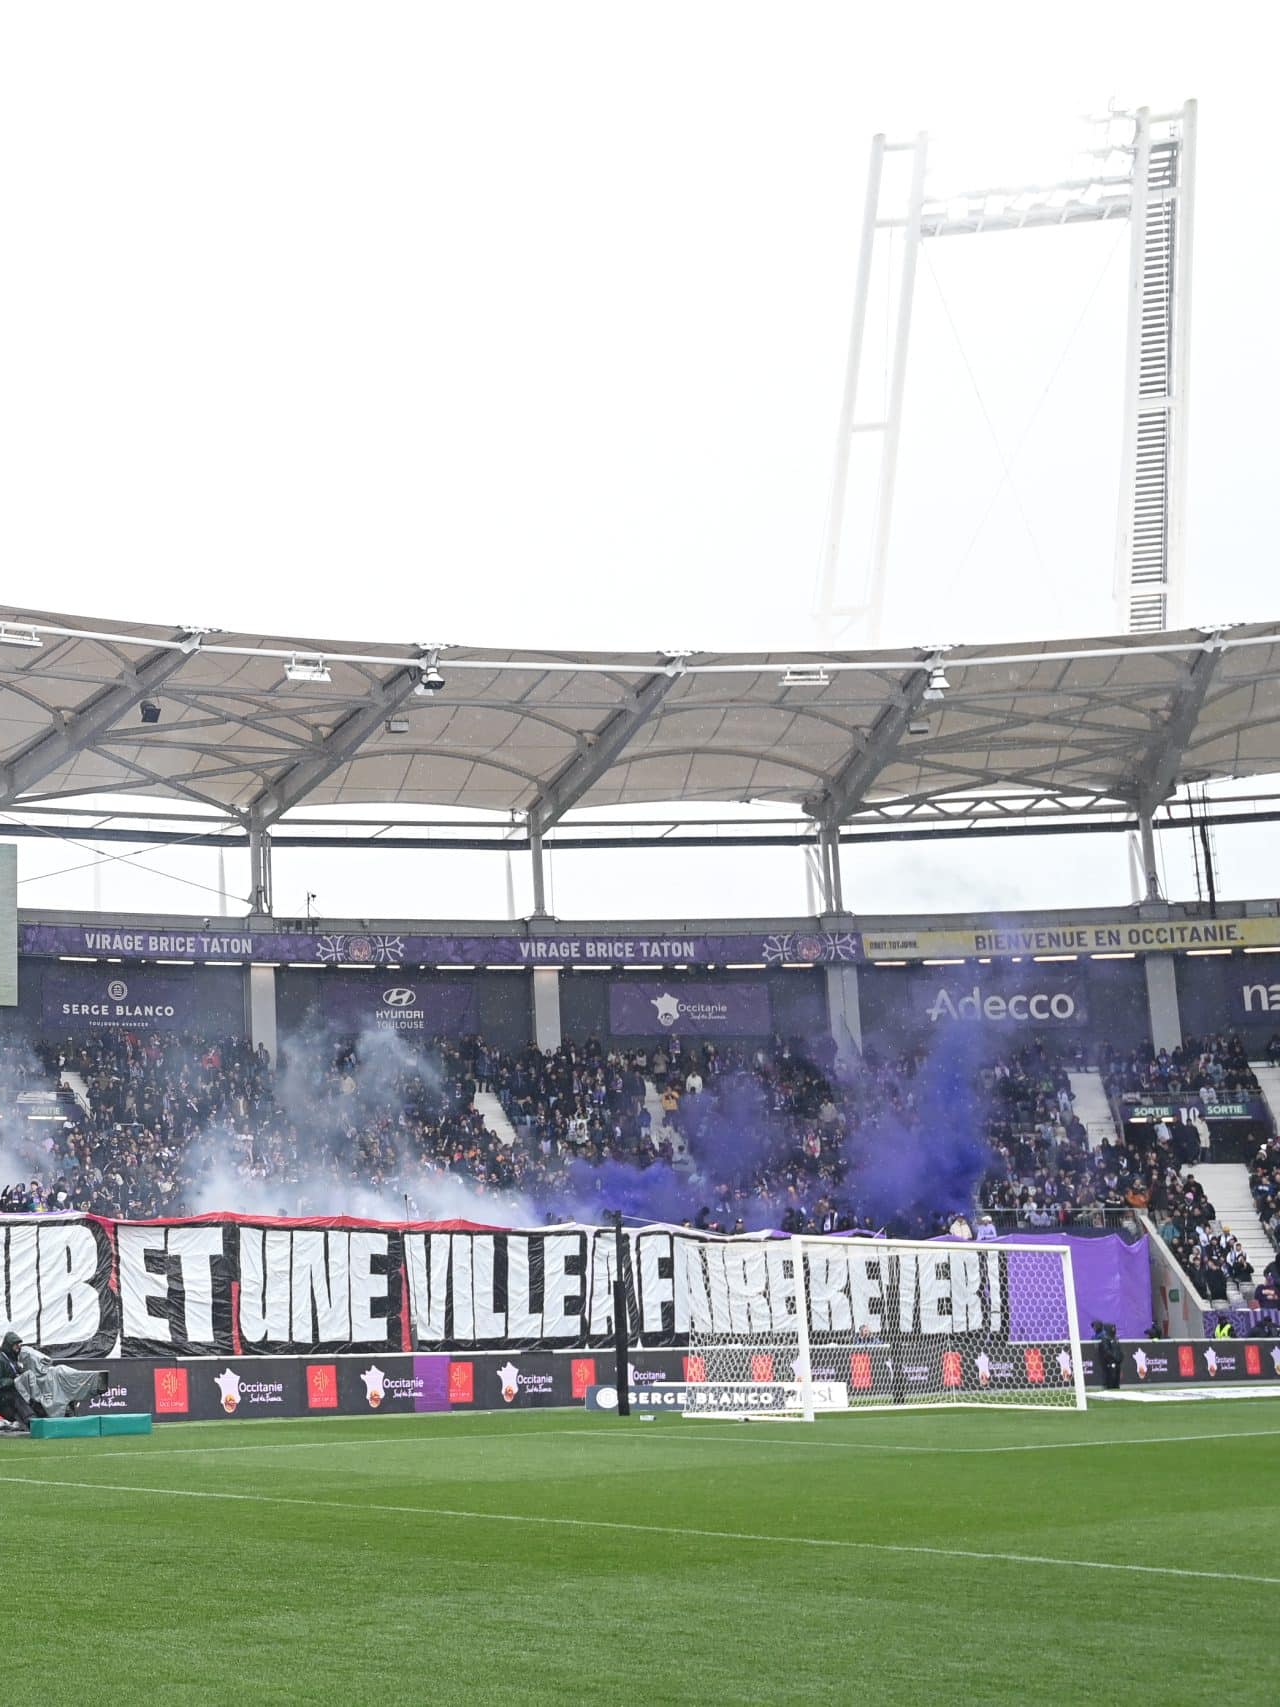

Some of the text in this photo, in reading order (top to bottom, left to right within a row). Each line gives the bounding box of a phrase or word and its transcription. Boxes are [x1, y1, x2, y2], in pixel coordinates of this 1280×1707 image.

[84, 933, 252, 954] VIRAGE BRICE TATON
[975, 924, 1245, 952] BIENVENUE EN OCCITANIE.
[519, 942, 695, 958] VIRAGE BRICE TATON
[62, 1003, 175, 1016] SERGE BLANCO
[678, 1002, 728, 1013] Occitanie
[926, 986, 1075, 1022] Adecco
[376, 1010, 424, 1019] HYUNDAI
[1134, 1106, 1169, 1116] SORTIE
[1207, 1105, 1243, 1115] SORTIE
[121, 1226, 224, 1343] ET
[238, 1228, 388, 1343] UNE
[403, 1233, 582, 1341] VILLE
[517, 1373, 553, 1385] Occitanie
[633, 1367, 666, 1382] Occitanie
[238, 1381, 283, 1393] Occitanie
[383, 1377, 424, 1389] Occitanie
[627, 1391, 773, 1405] SERGE BLANCO
